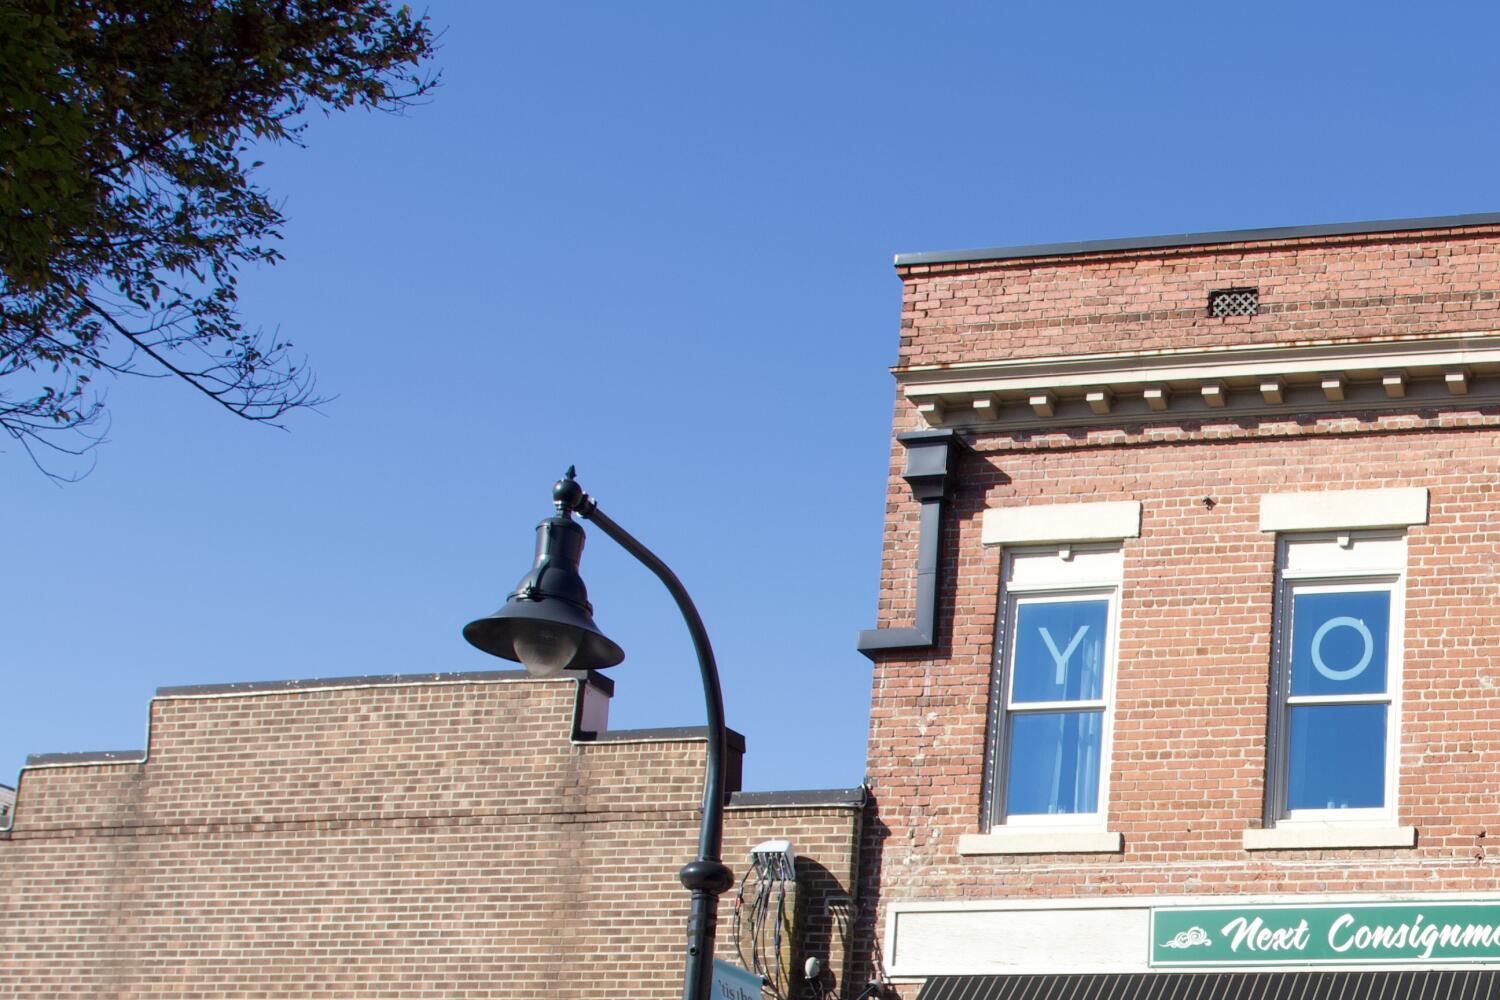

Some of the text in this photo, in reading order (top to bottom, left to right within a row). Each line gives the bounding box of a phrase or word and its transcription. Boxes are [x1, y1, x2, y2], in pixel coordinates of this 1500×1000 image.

[1038, 625, 1090, 685] Y
[1310, 615, 1374, 681] O
[1222, 915, 1311, 952] Next
